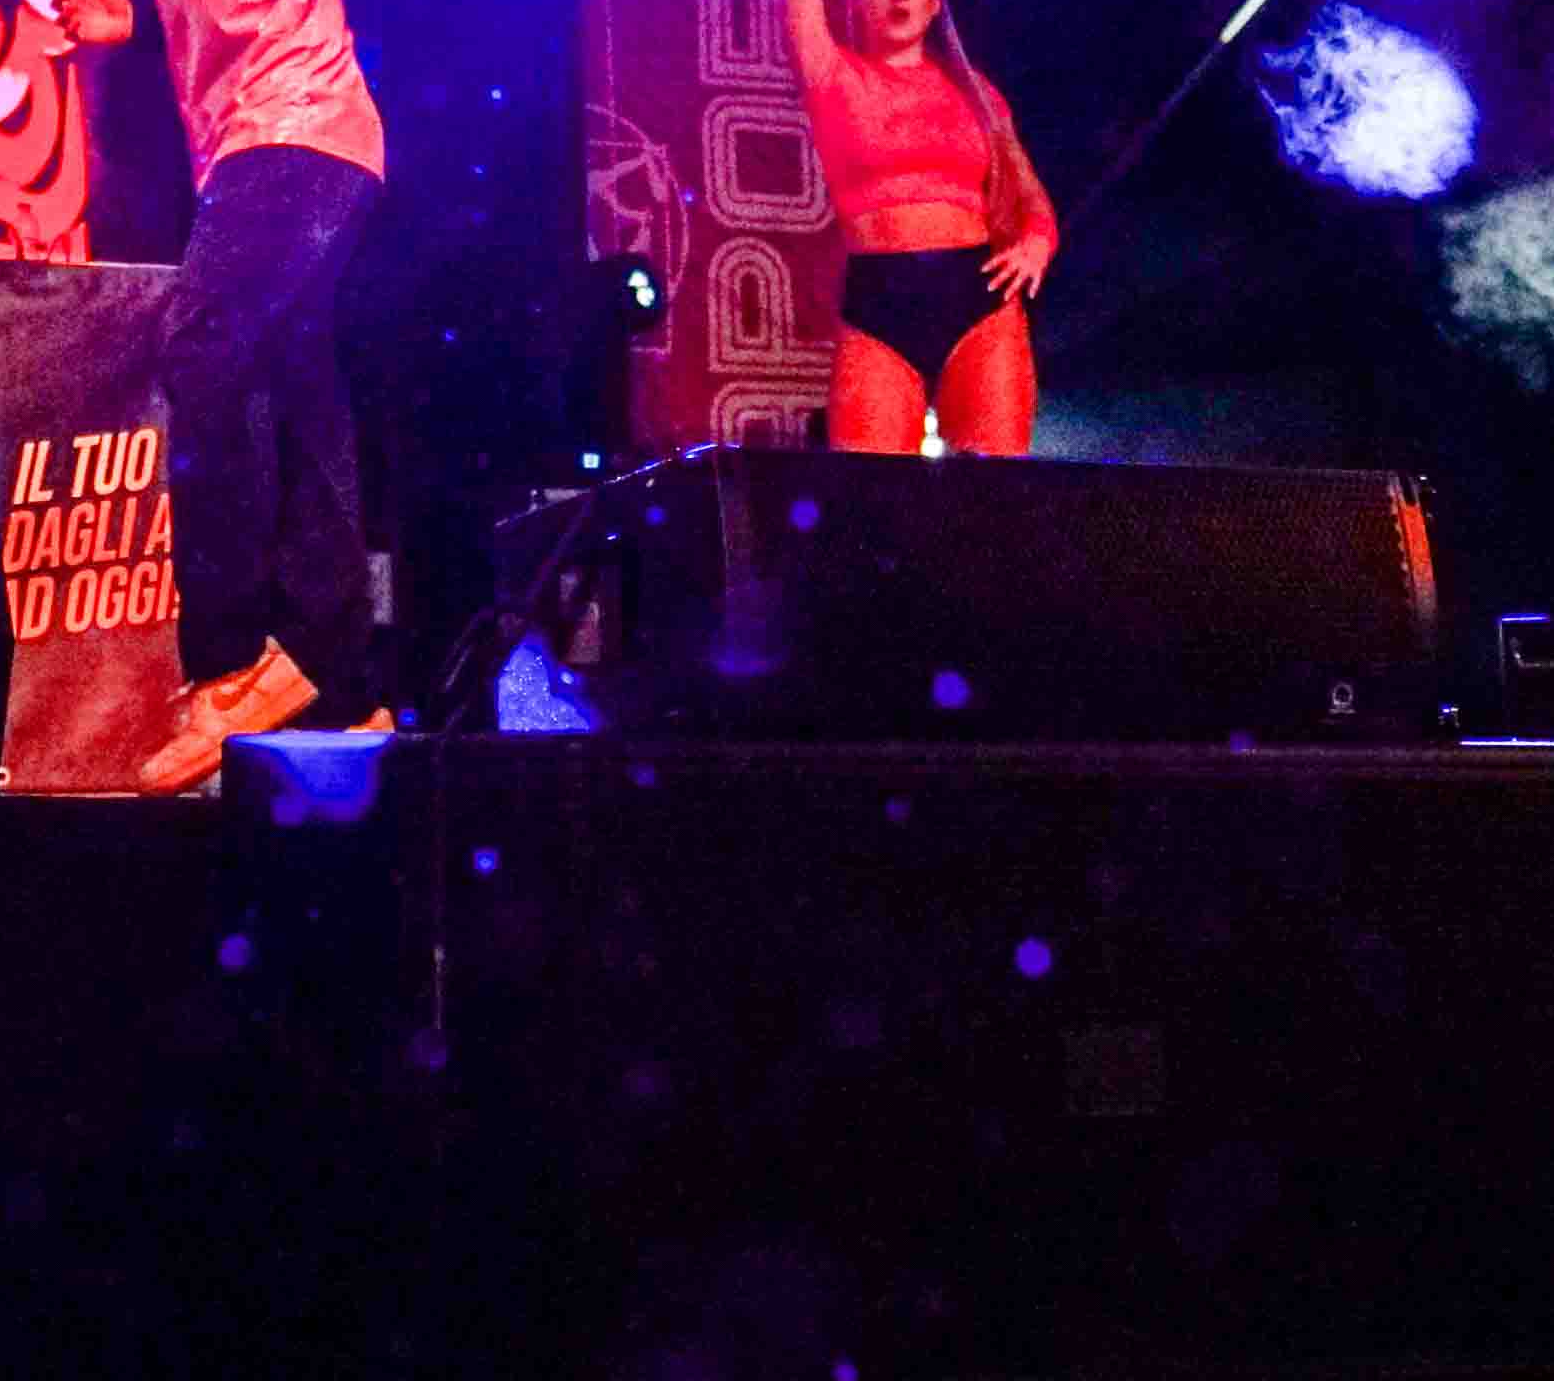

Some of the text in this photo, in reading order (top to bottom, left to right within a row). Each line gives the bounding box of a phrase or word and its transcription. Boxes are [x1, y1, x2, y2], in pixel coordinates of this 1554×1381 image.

[13, 427, 158, 505] IL TUO
[2, 496, 137, 574] DAGLI
